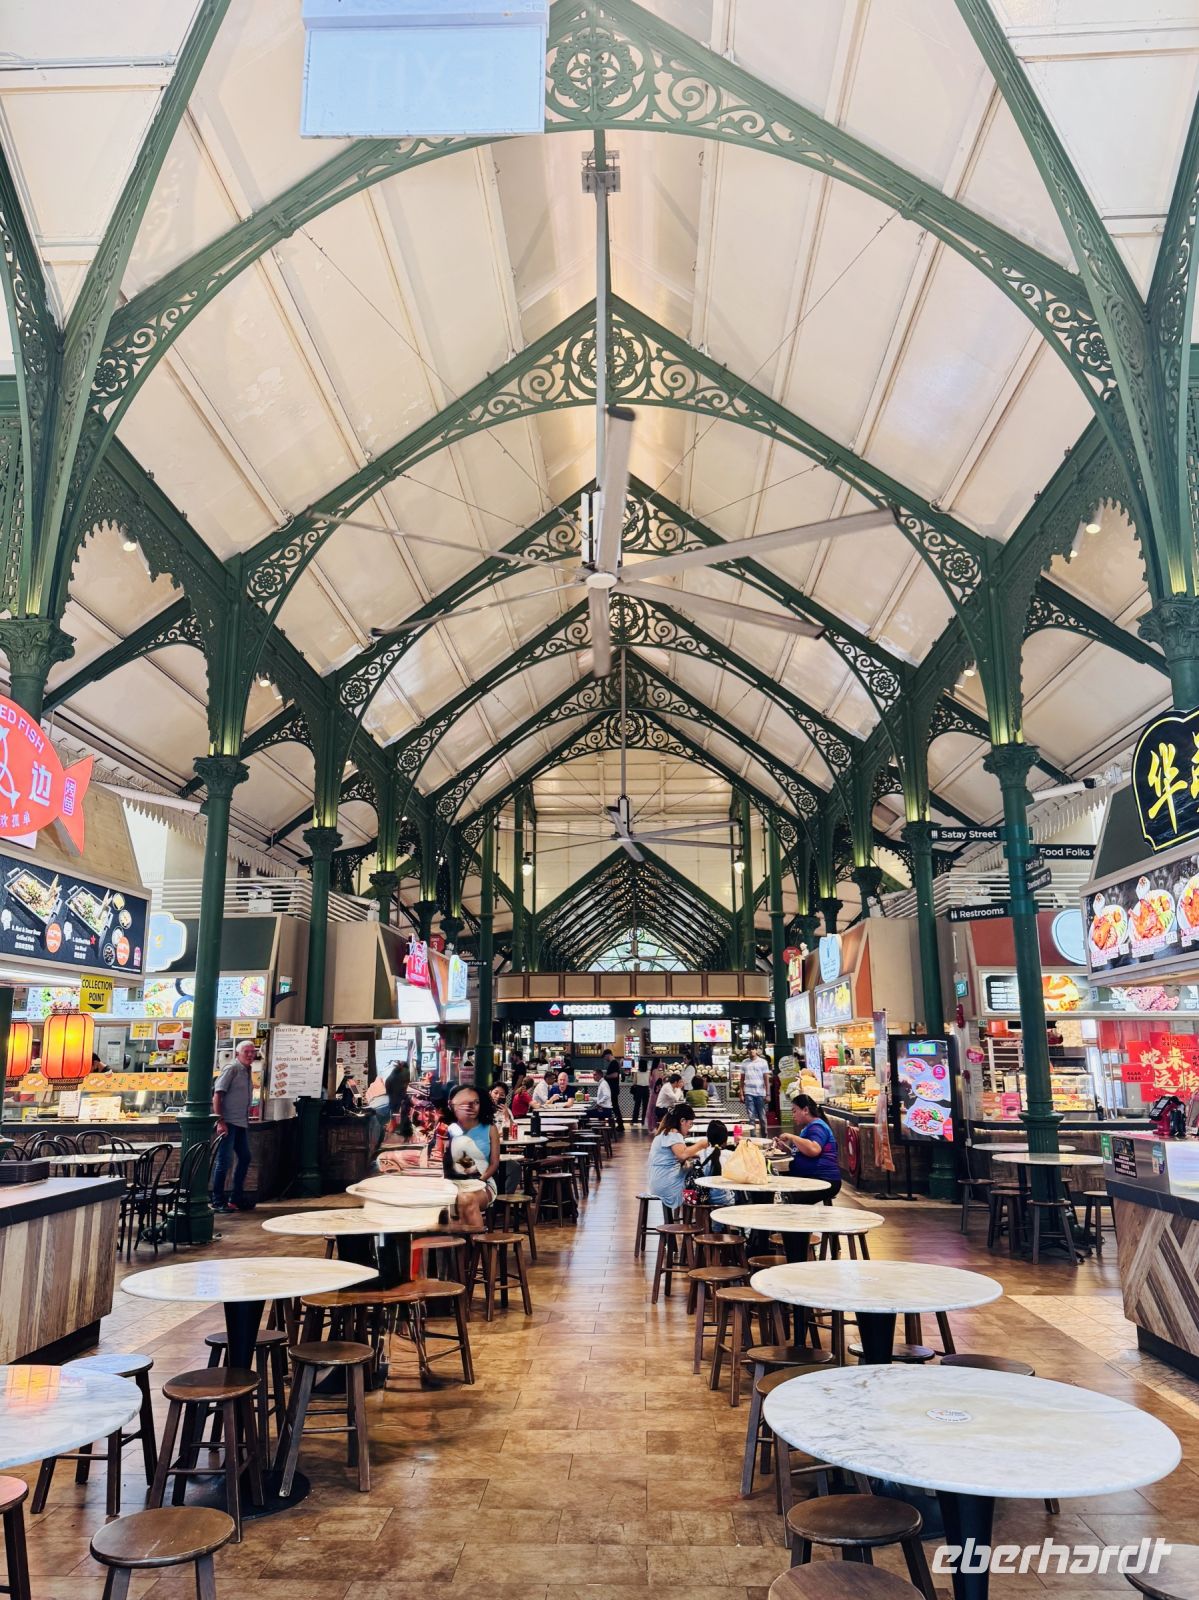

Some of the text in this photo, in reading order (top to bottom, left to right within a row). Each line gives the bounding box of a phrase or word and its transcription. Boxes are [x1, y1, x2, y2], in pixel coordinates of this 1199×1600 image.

[17, 716, 45, 754] FISH
[1147, 731, 1199, 835] 华
[941, 830, 997, 840] Satay Street
[1039, 848, 1090, 857] Food Folks
[959, 907, 1005, 919] Restrooms
[82, 979, 113, 990] COLLECTION
[89, 992, 105, 1002] POINT
[563, 1004, 611, 1015] DESSERTS
[646, 1004, 723, 1015] FRUITS & JUICES
